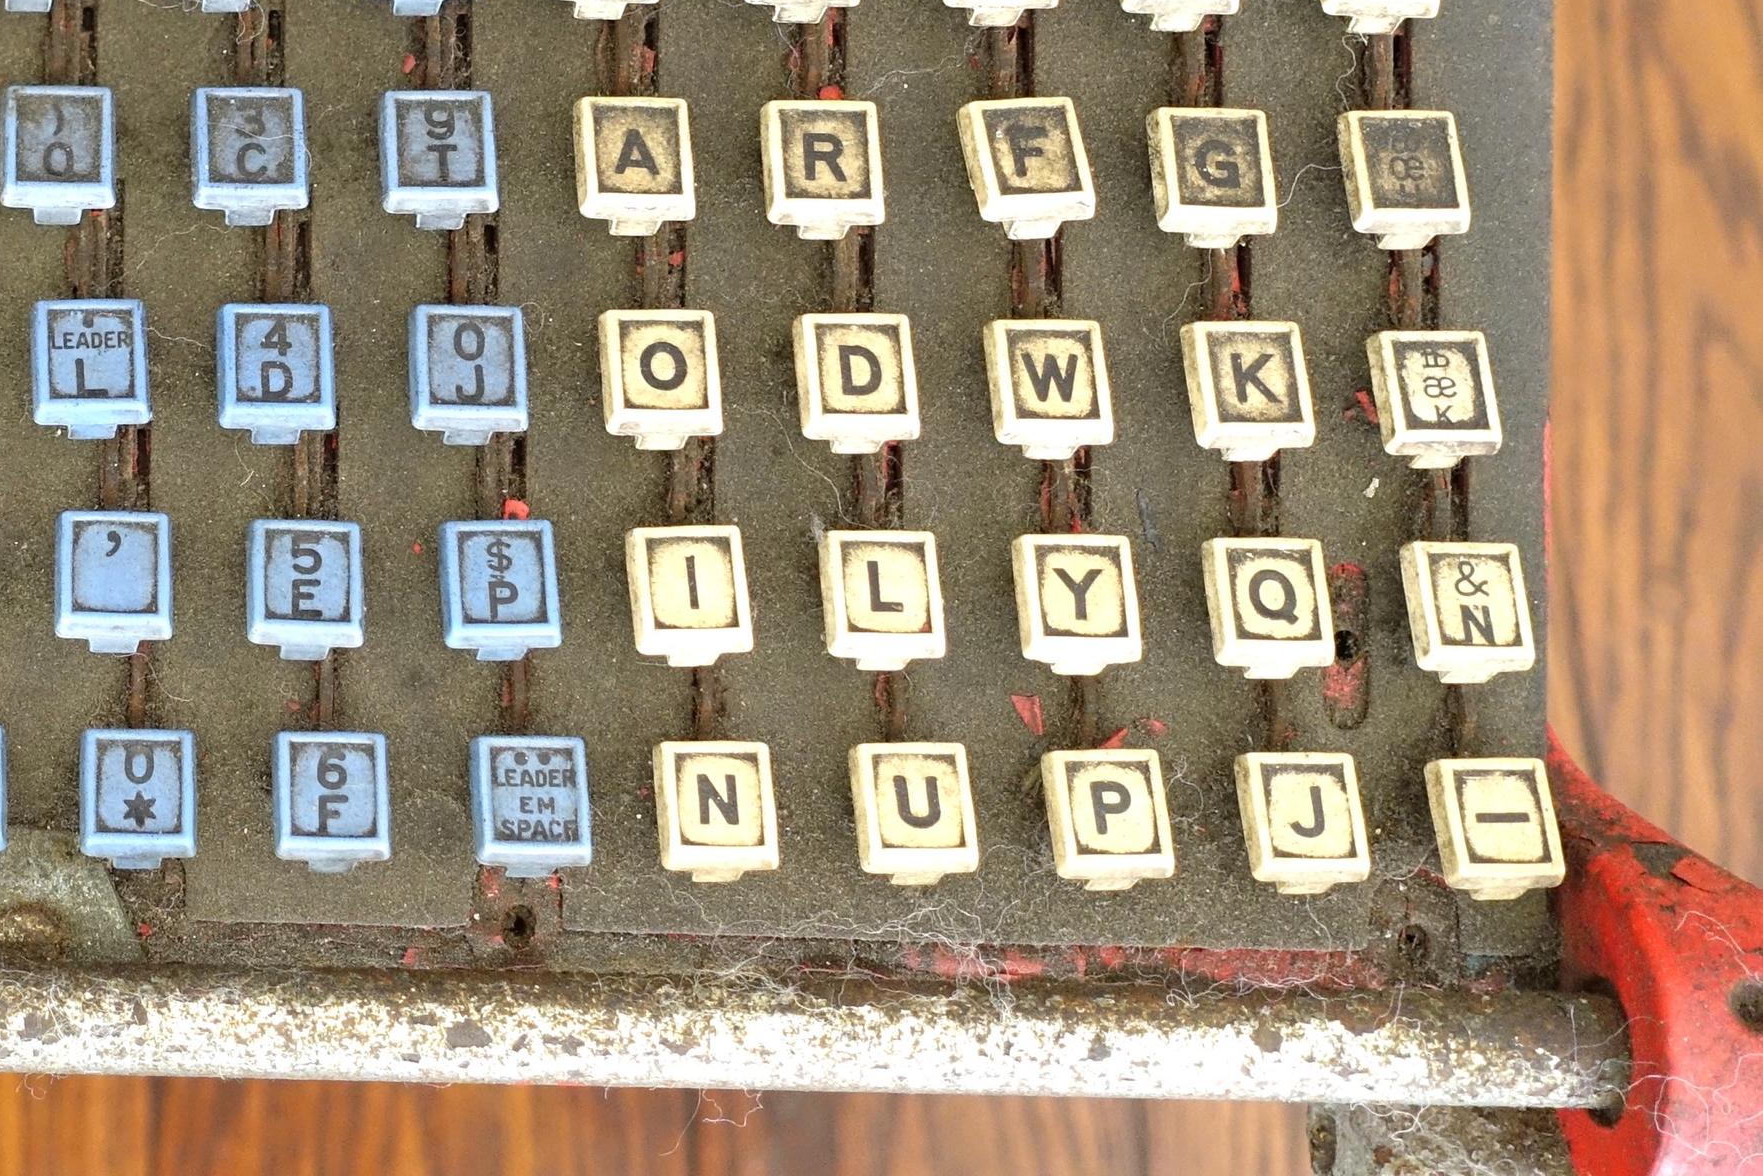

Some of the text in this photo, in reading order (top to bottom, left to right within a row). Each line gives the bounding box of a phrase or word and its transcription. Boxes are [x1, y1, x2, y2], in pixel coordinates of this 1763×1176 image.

[424, 101, 455, 140] 9
[237, 142, 268, 178] C
[426, 144, 458, 182] T
[615, 129, 659, 176] A
[803, 133, 846, 182] R
[1004, 125, 1047, 177] F
[1195, 140, 1240, 188] G
[51, 331, 133, 349] LEADER
[259, 321, 292, 356] 4
[75, 358, 109, 398] L
[261, 361, 293, 400] D
[455, 366, 485, 404] J
[640, 342, 687, 391] O
[838, 345, 882, 396] D
[1021, 352, 1079, 403] W
[1231, 352, 1281, 404] K
[292, 534, 323, 575] 5
[486, 537, 512, 579] $
[292, 579, 323, 618] E
[867, 560, 904, 612] L
[1053, 568, 1102, 620] Y
[1248, 569, 1299, 625] Q
[1454, 560, 1489, 597] &
[488, 580, 518, 620] P
[1459, 605, 1495, 644] N
[316, 750, 348, 790] 6
[493, 768, 576, 787] LEADER
[318, 794, 350, 834] F
[519, 796, 555, 814] EM
[697, 773, 739, 825] N
[894, 776, 941, 828] U
[1090, 782, 1131, 835] P
[1291, 786, 1325, 839] J
